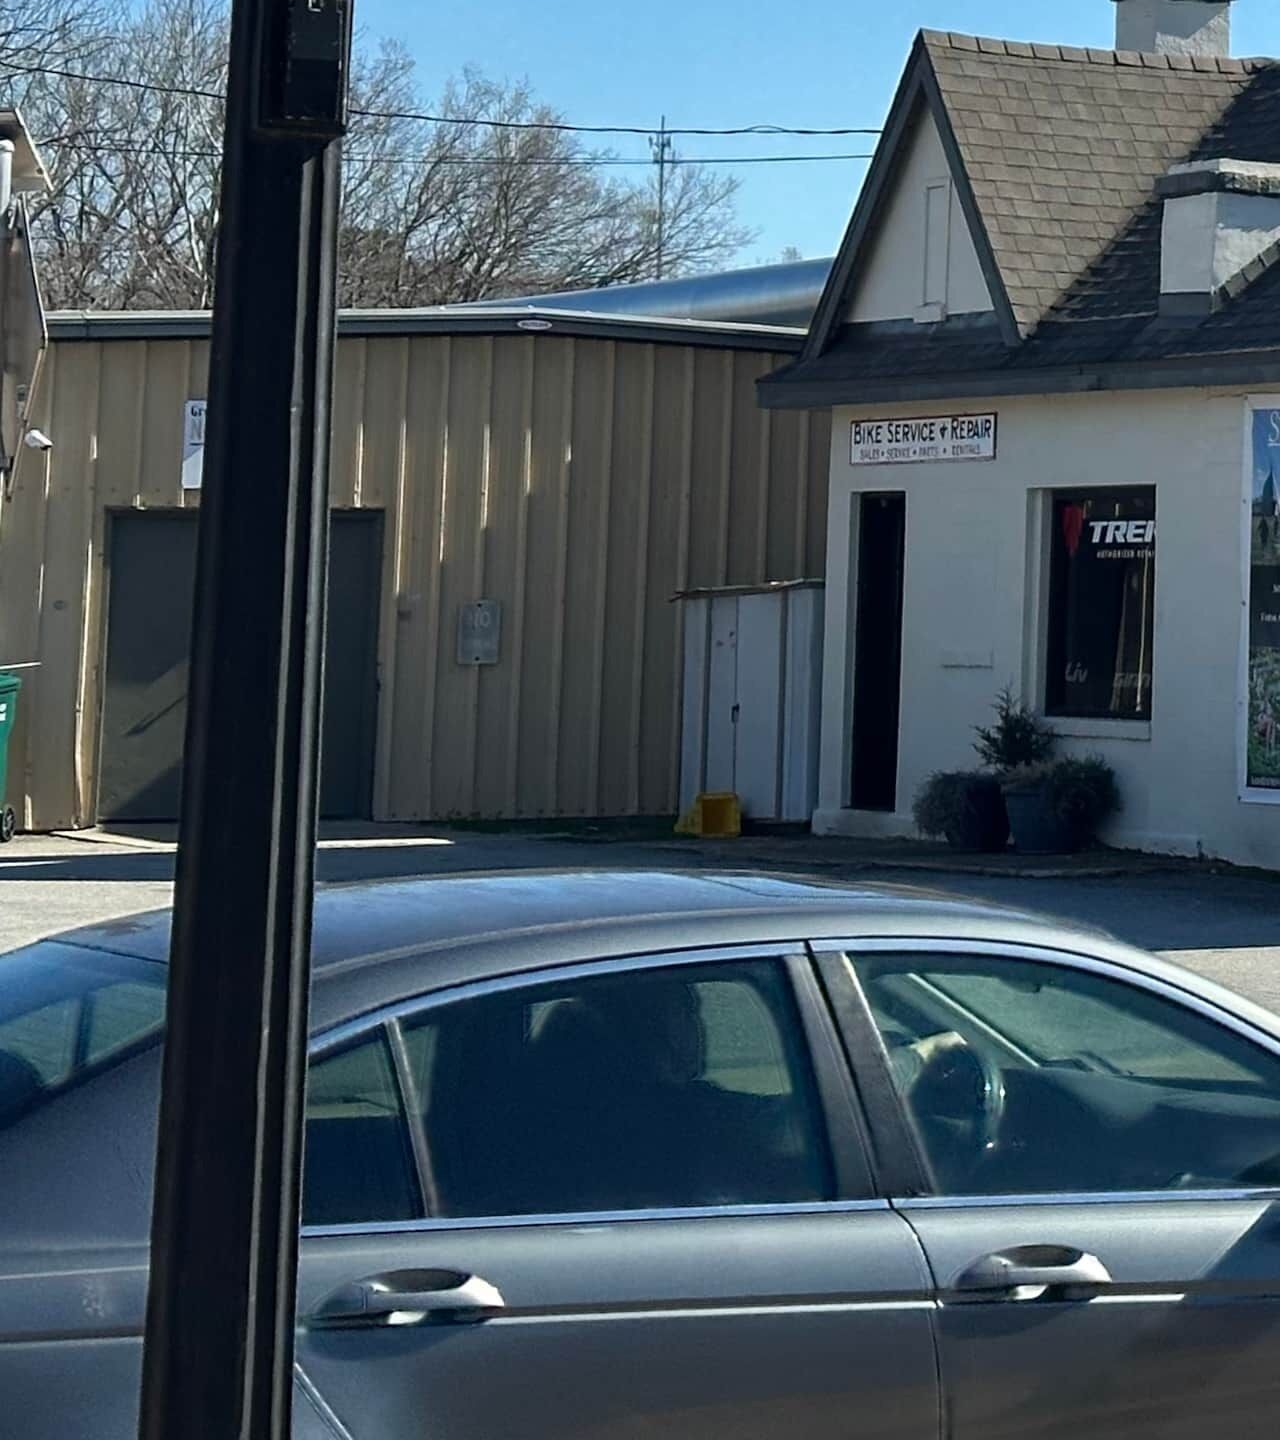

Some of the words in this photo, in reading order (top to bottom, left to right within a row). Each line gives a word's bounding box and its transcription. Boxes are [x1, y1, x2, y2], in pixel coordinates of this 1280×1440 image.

[853, 423, 883, 445] BIKE
[887, 422, 936, 444] SERVICE
[951, 417, 992, 440] REPAIR
